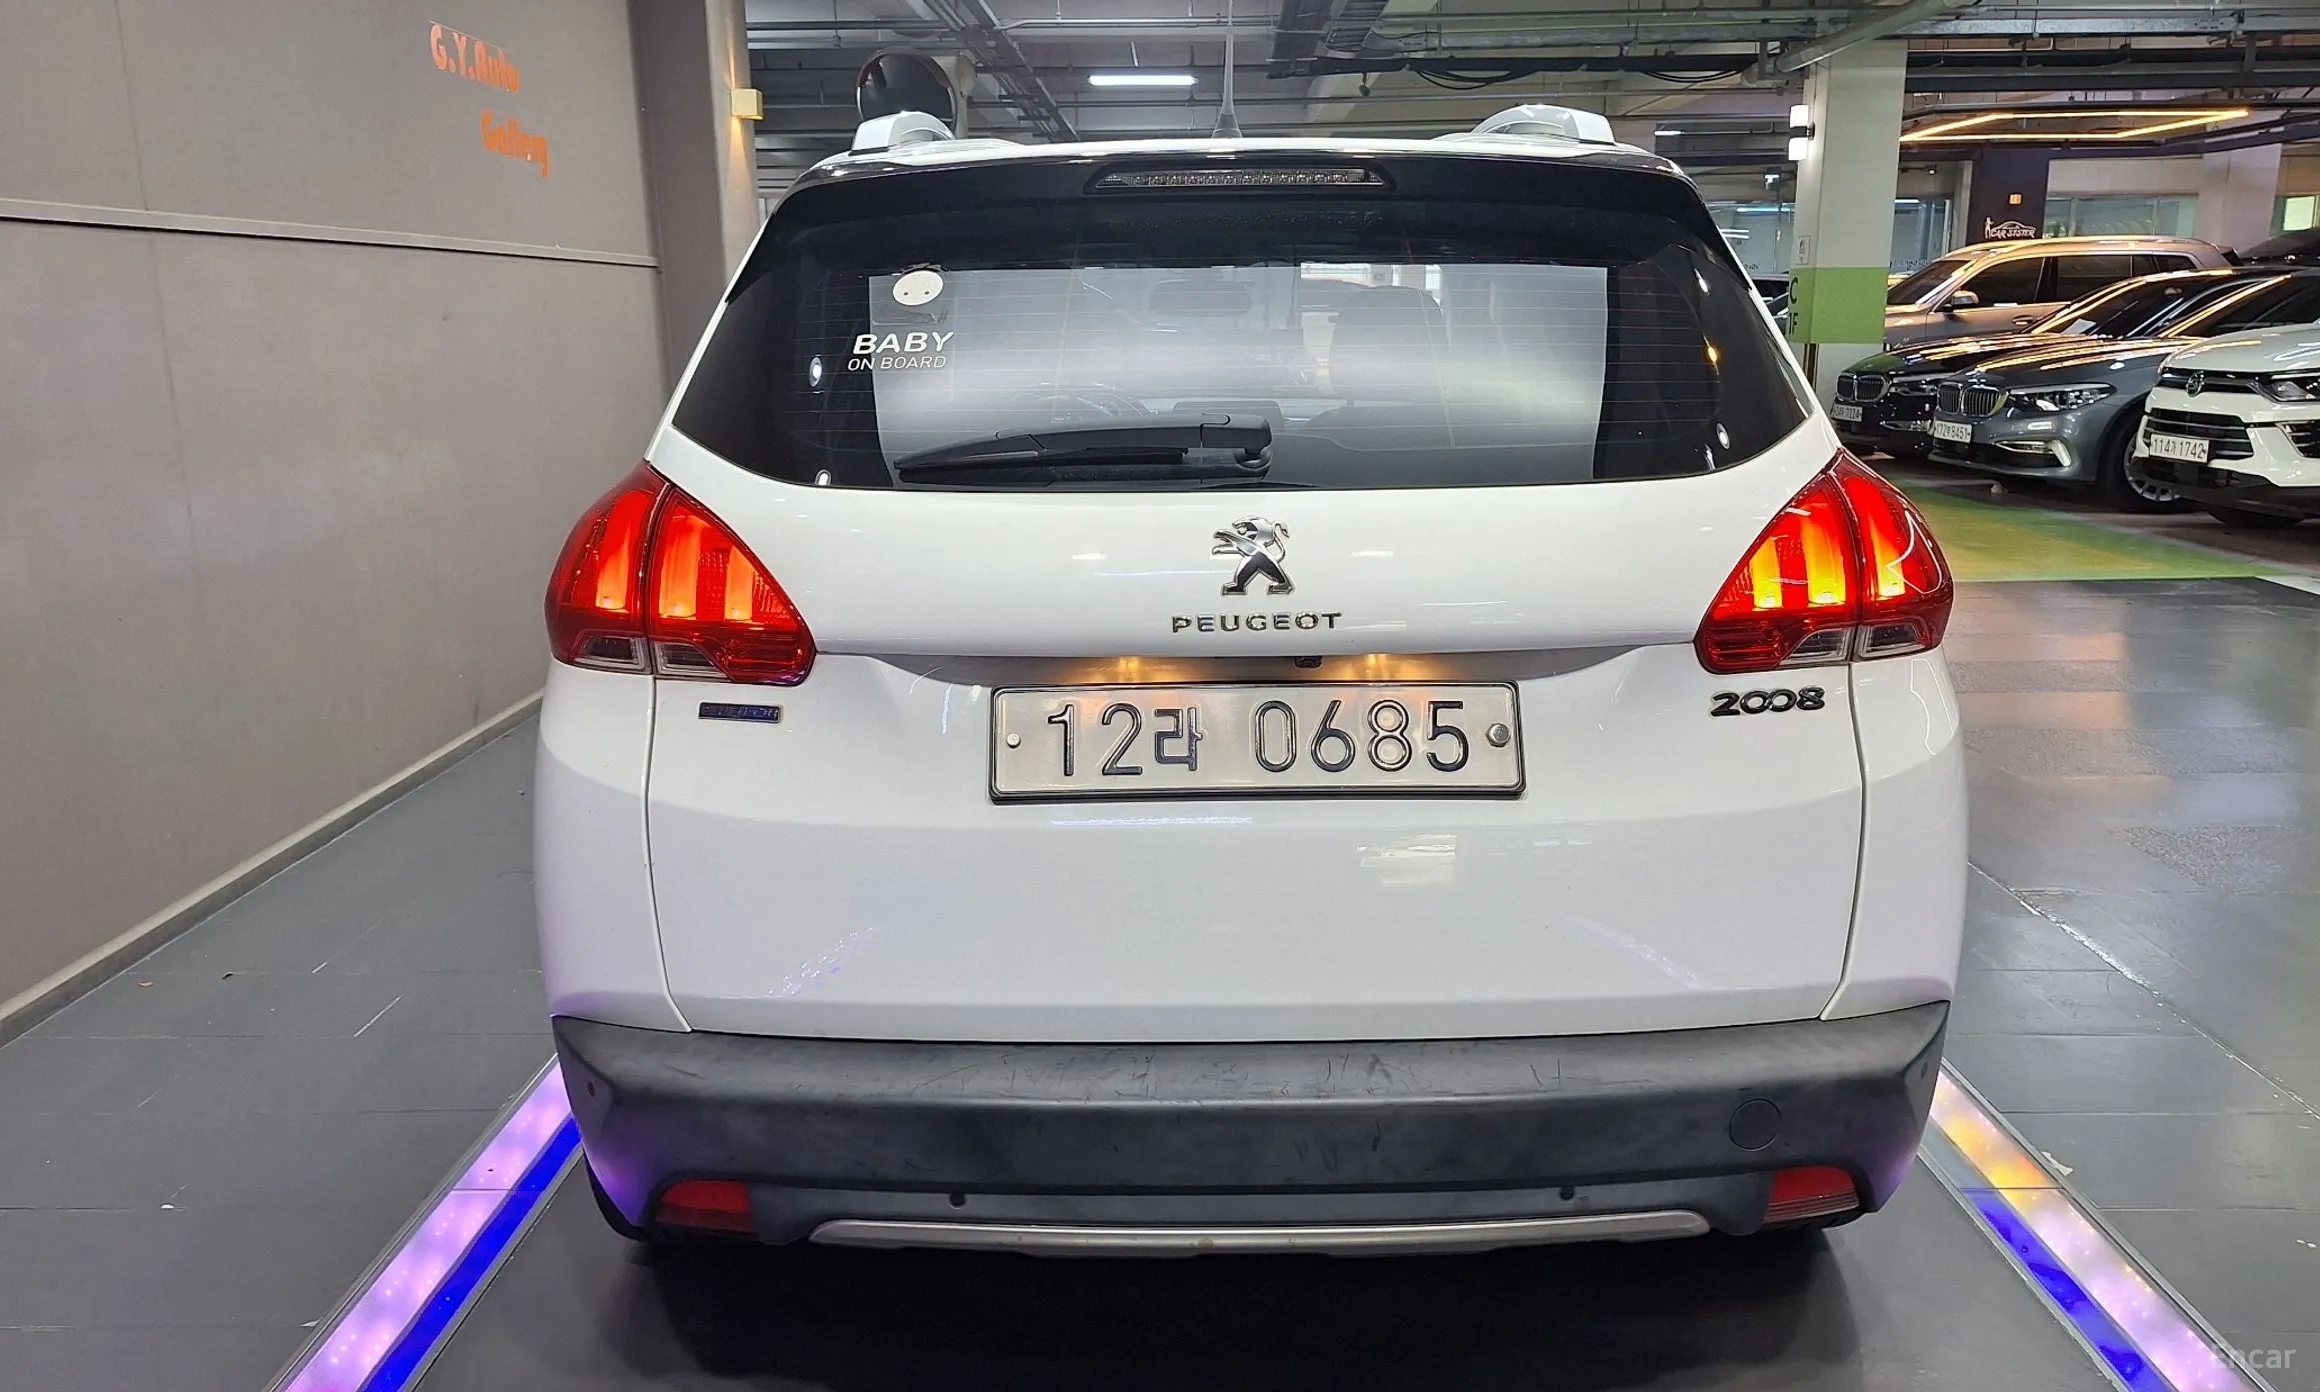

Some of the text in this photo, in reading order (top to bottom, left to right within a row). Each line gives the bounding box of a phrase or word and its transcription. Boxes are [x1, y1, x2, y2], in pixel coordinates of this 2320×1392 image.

[852, 331, 954, 355] BABY
[847, 356, 947, 371] ON BOARD
[1171, 612, 1342, 633] PEUGEOT
[1710, 686, 1826, 717] 2008
[1047, 699, 1469, 777] 12라 0685
